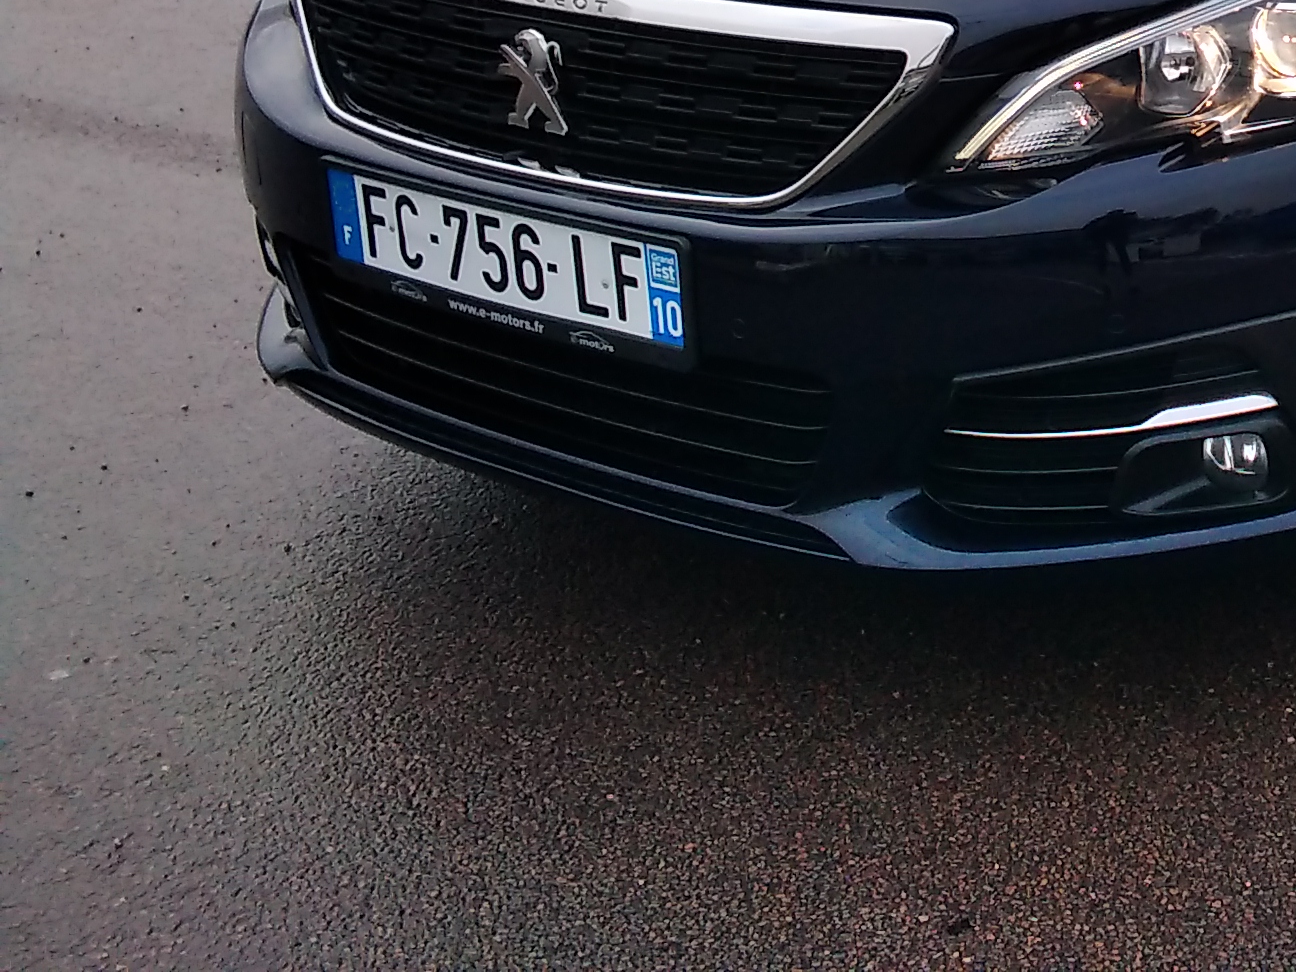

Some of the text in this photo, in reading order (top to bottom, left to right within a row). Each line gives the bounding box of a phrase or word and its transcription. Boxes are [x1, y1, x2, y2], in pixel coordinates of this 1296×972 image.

[343, 224, 353, 245] F
[361, 183, 642, 322] FC-756-LF
[651, 252, 675, 265] Grand
[652, 262, 675, 281] Est
[447, 299, 545, 334] www.e-motors.fr
[653, 296, 683, 337] 10
